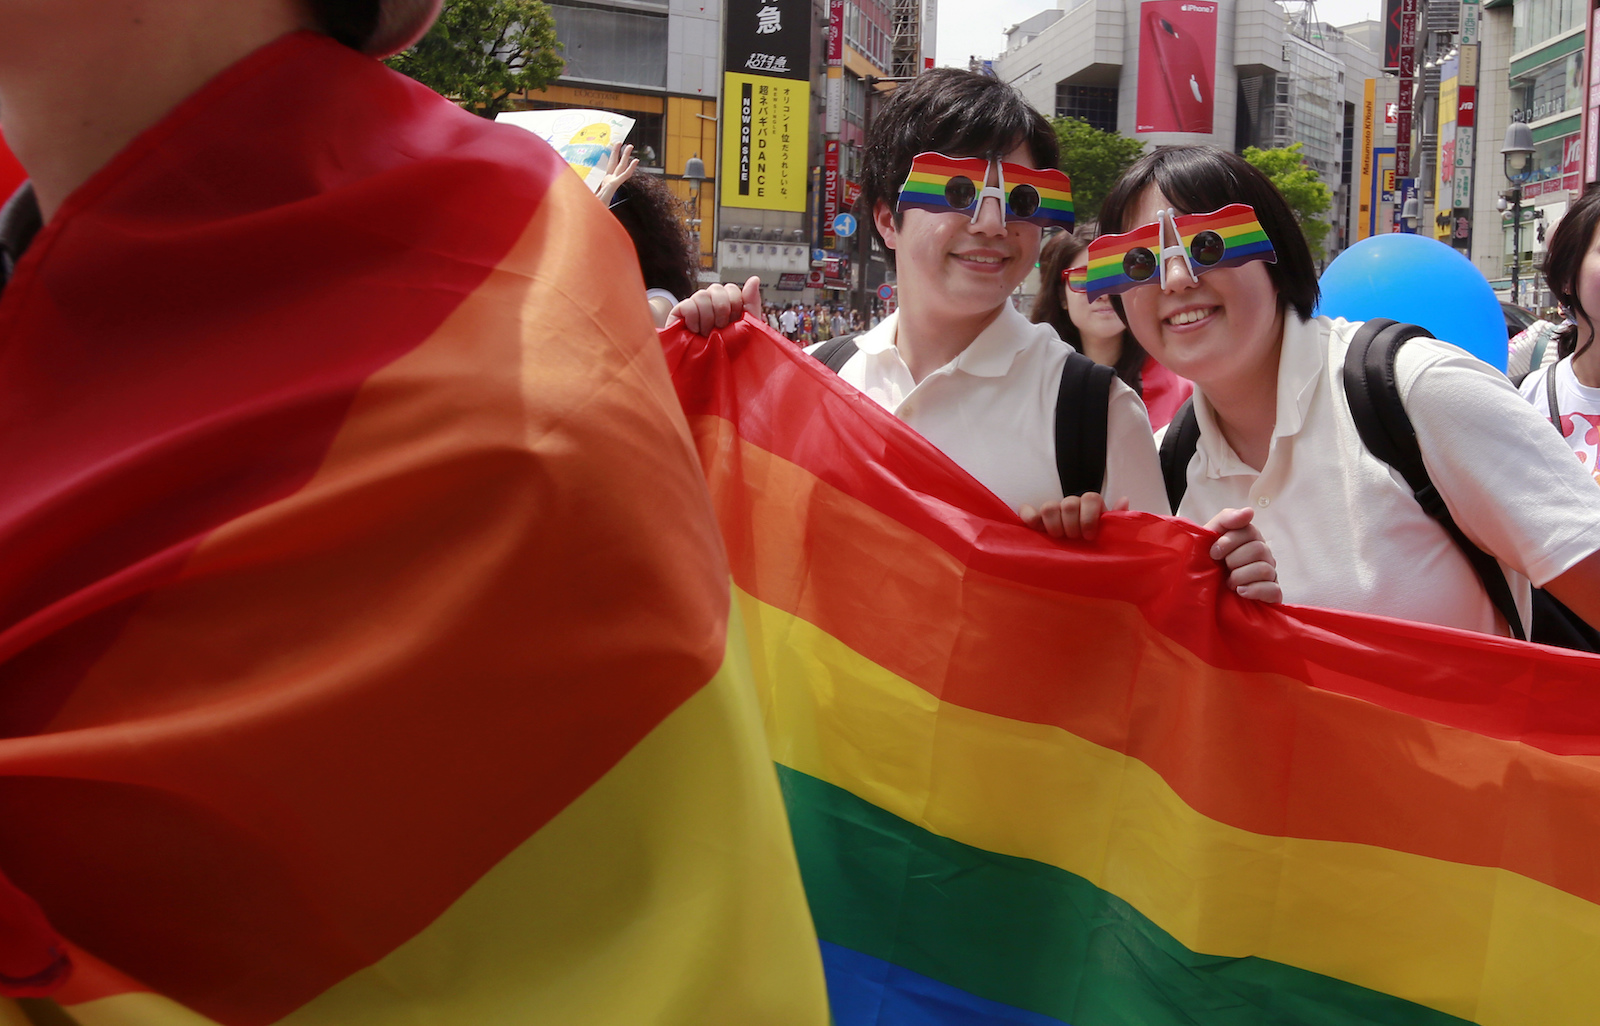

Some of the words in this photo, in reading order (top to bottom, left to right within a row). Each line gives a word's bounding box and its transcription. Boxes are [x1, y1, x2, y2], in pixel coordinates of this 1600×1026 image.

[756, 0, 782, 34] 急
[1187, 5, 1209, 13] iPhone
[741, 98, 751, 124] NOW
[1459, 102, 1474, 111] JTB
[741, 126, 750, 144] ON
[740, 146, 749, 181] SALE
[1363, 130, 1371, 176] Matsumoto
[1565, 138, 1581, 168] JTB
